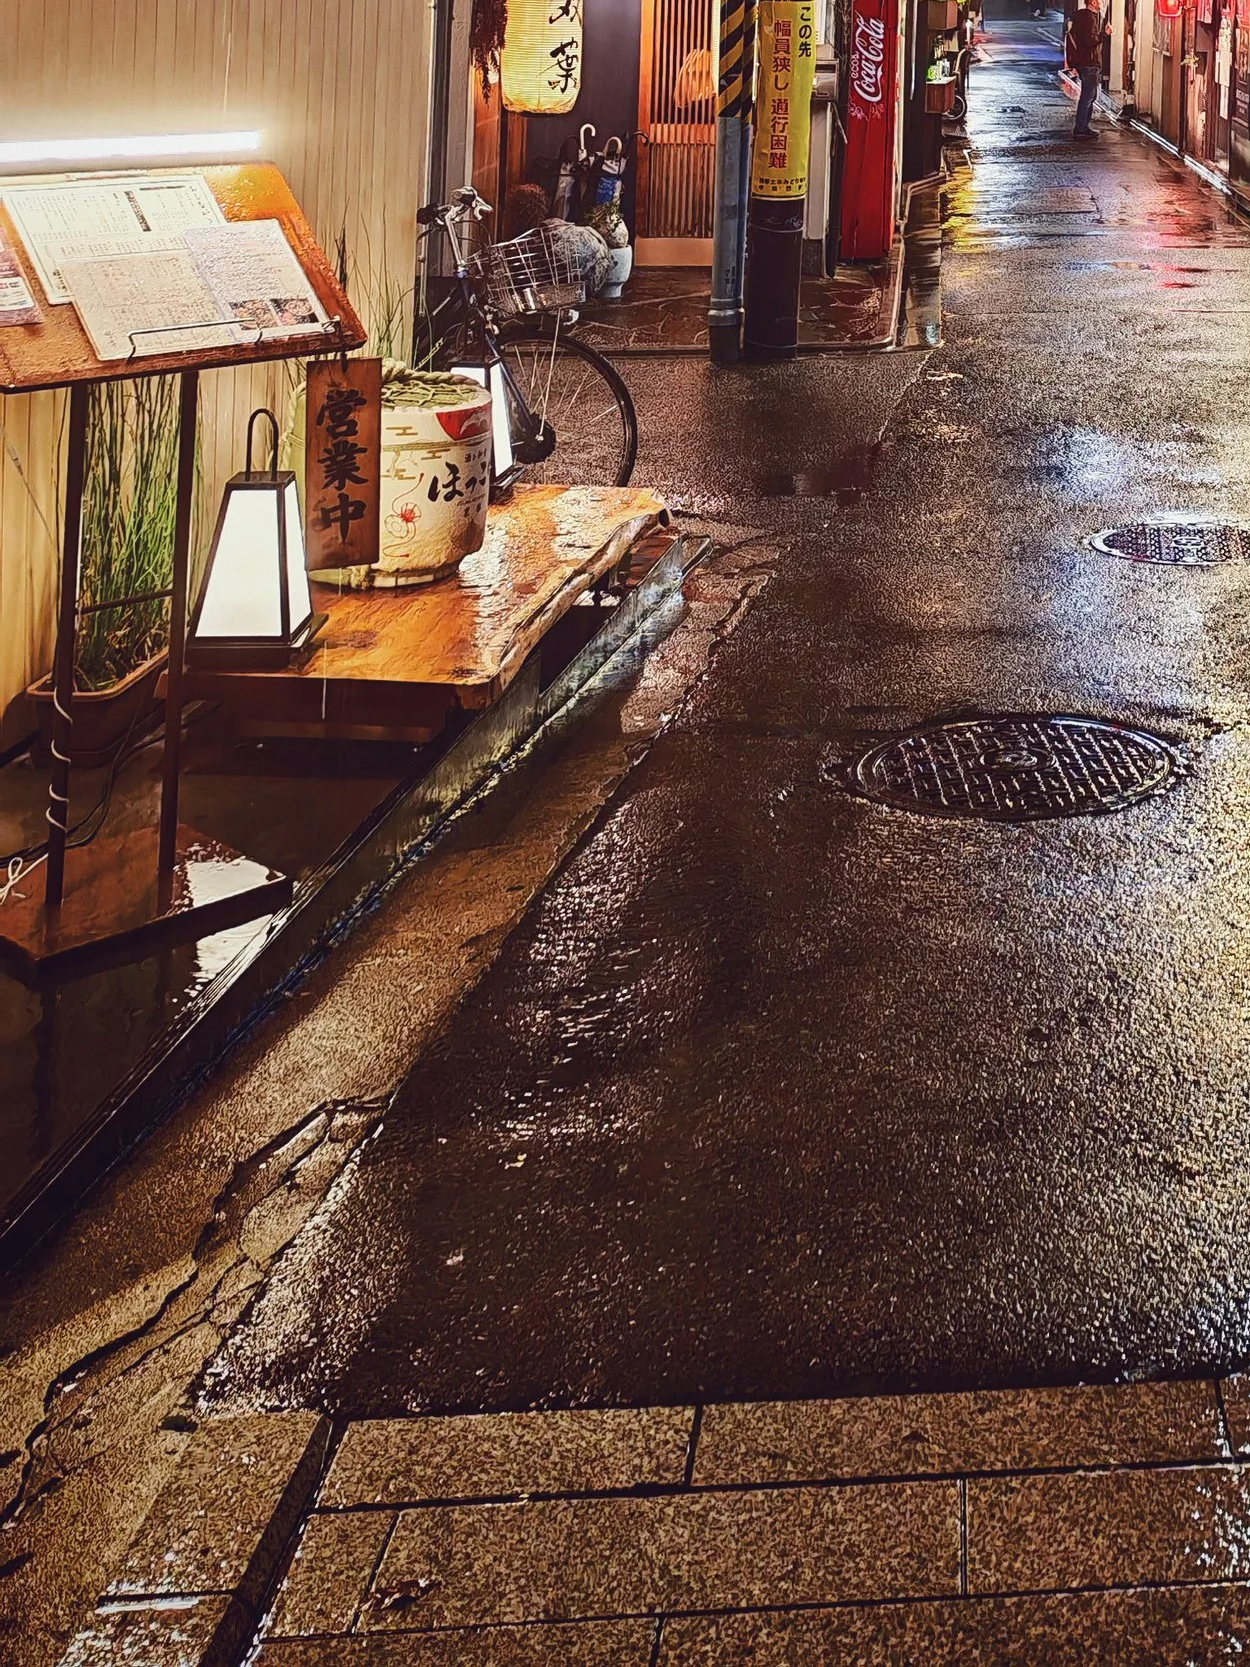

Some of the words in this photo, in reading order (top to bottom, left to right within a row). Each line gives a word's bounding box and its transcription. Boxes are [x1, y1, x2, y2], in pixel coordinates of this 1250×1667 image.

[773, 19, 792, 92] 幅員狭し
[798, 6, 813, 58] この先
[768, 98, 790, 169] 通行困難
[316, 388, 370, 544] 営業中
